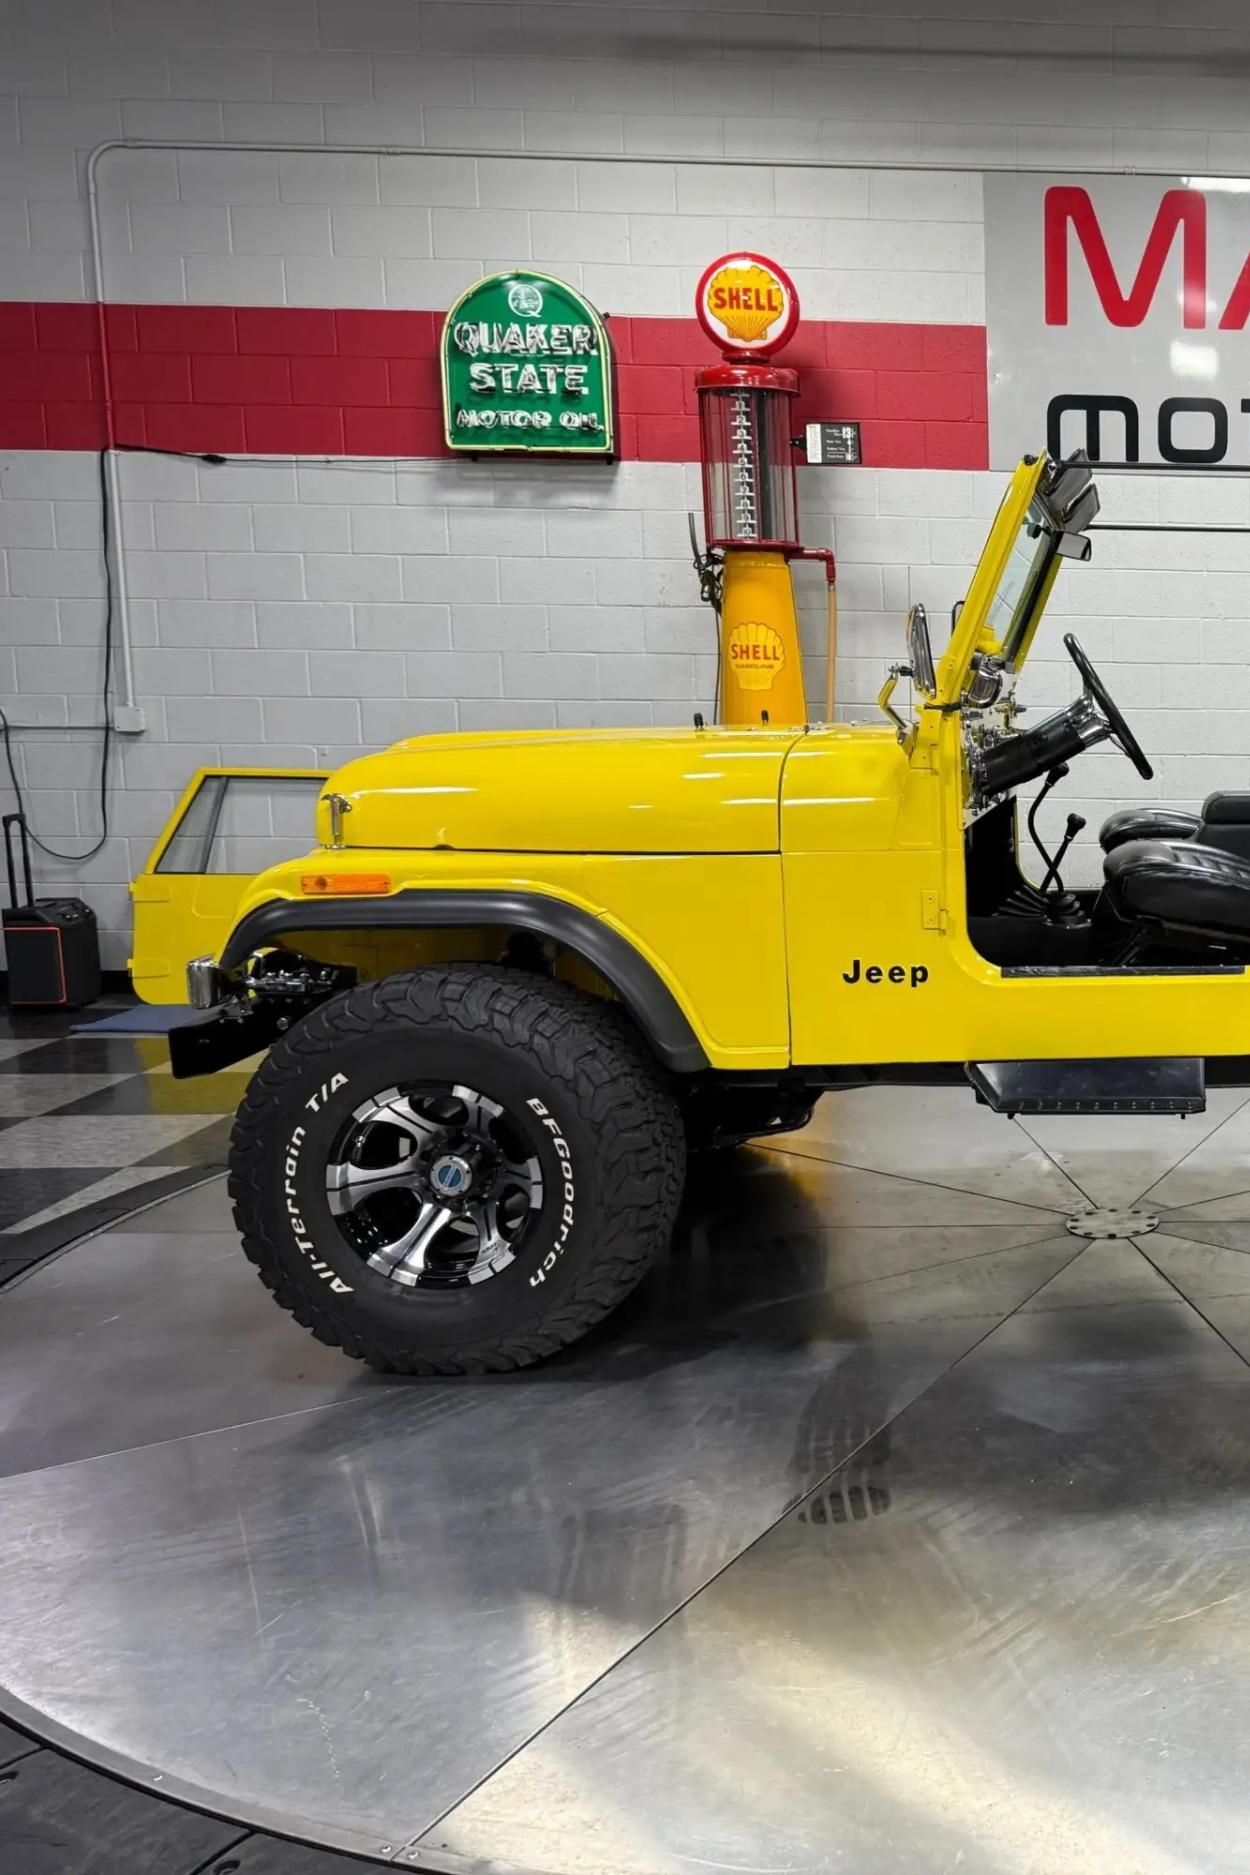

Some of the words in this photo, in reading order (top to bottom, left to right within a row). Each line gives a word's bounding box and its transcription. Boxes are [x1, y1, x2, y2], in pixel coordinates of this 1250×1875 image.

[713, 287, 778, 312] SHELL
[454, 320, 599, 356] QUAKER
[469, 362, 589, 395] STATE
[456, 409, 553, 429] MOTOR
[559, 410, 604, 432] OIL
[730, 643, 780, 661] SHELL
[842, 959, 929, 987] Jeep
[305, 1072, 349, 1112] T/A
[525, 1097, 574, 1287] BFGoodrich
[286, 1126, 355, 1293] All-Terrain
